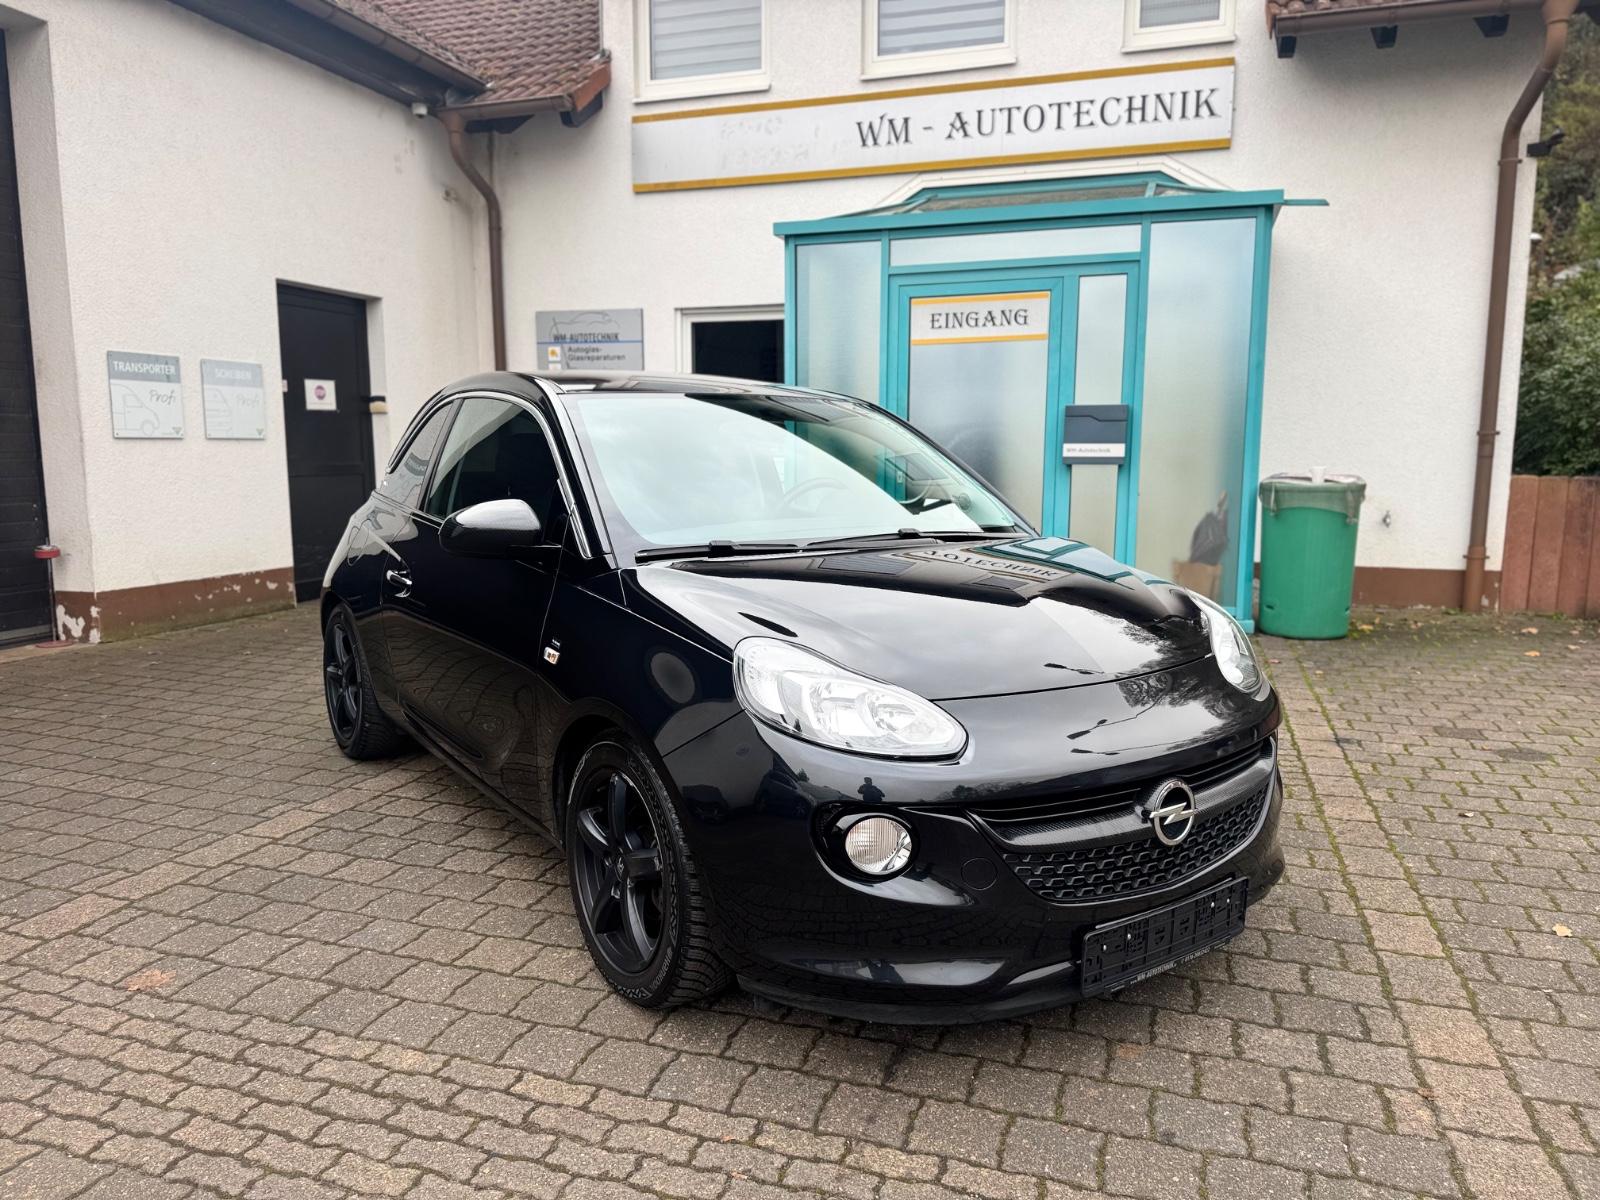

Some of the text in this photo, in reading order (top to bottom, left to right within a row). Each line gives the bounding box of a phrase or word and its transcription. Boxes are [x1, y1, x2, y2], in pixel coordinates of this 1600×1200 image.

[856, 113, 911, 148] WM
[944, 88, 1220, 143] AUTOTECHNIK
[930, 309, 1030, 330] EINGANG
[567, 354, 626, 362] Glasreparaturen
[113, 360, 177, 376] TRANSPORTER
